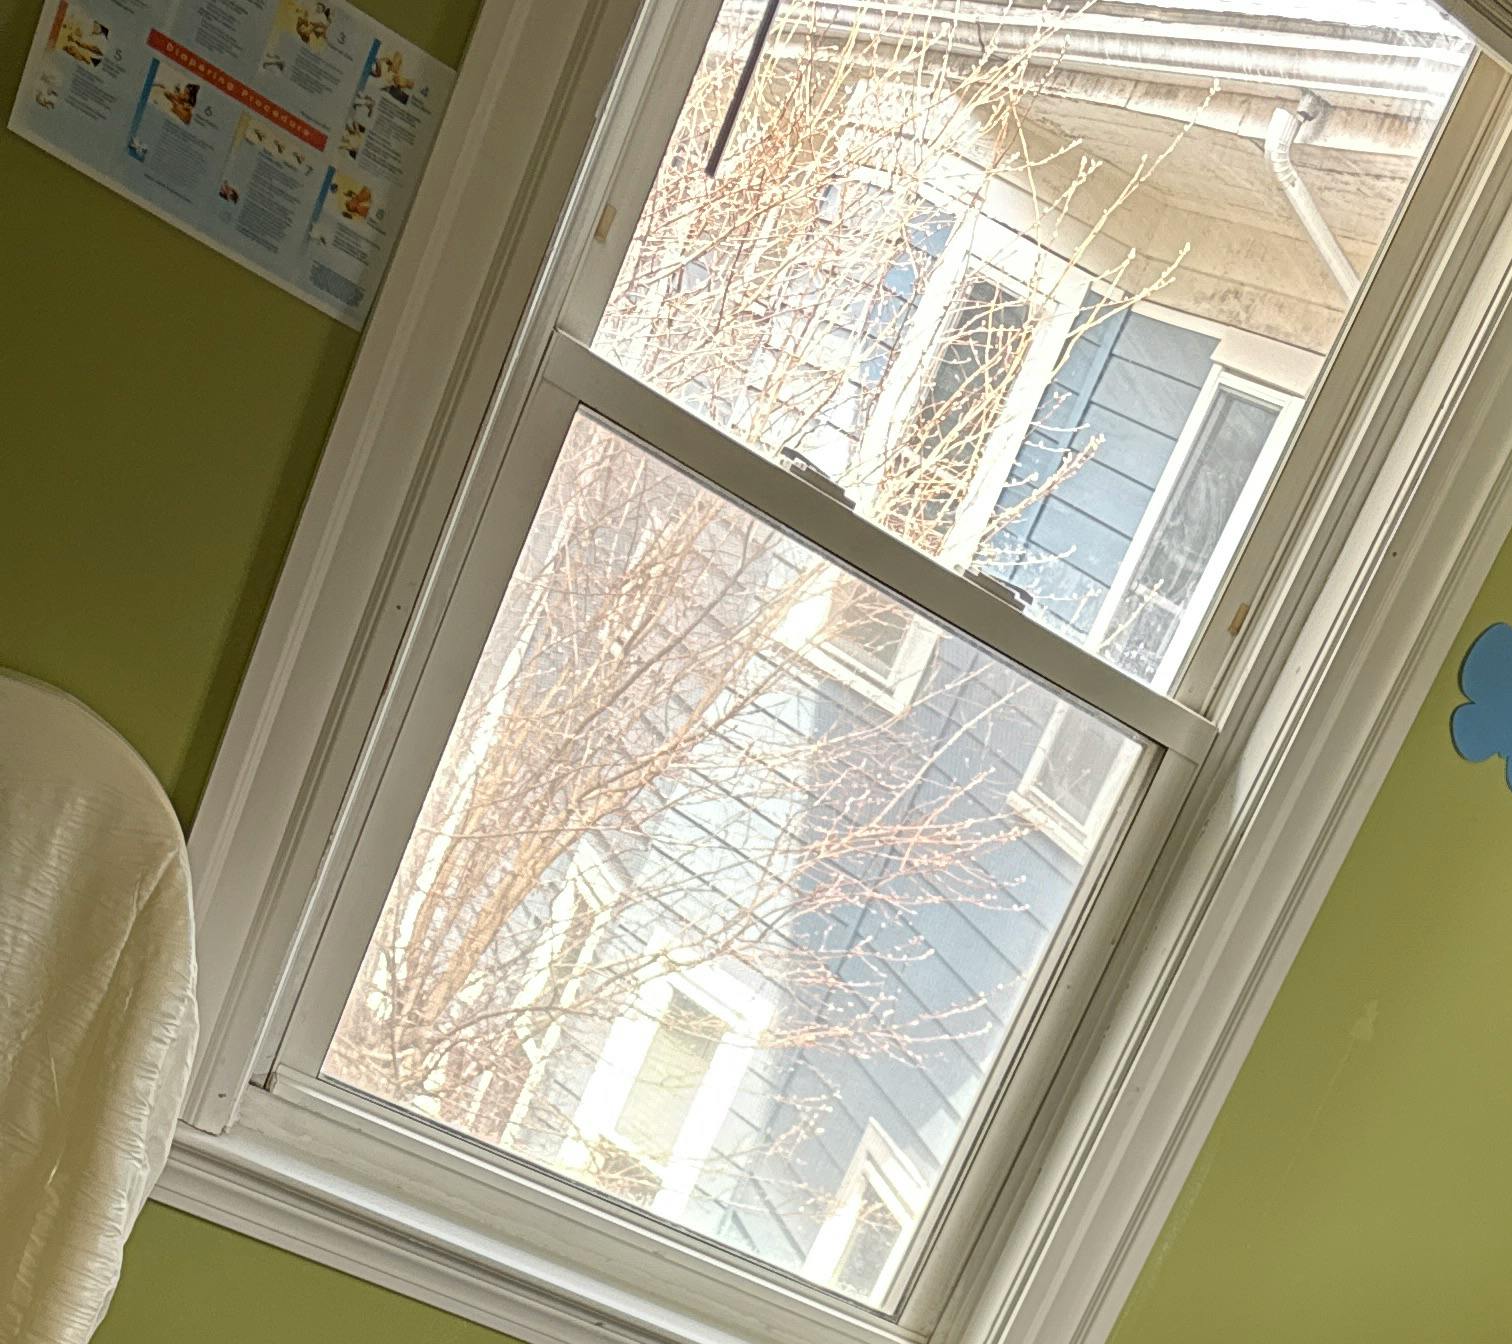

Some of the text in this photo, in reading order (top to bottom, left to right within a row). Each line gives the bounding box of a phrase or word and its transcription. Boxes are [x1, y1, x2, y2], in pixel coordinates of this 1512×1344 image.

[337, 31, 347, 45] 3
[113, 49, 123, 62] 5
[166, 42, 235, 92] Diapering
[241, 88, 311, 137] Procedure
[204, 105, 213, 117] 6
